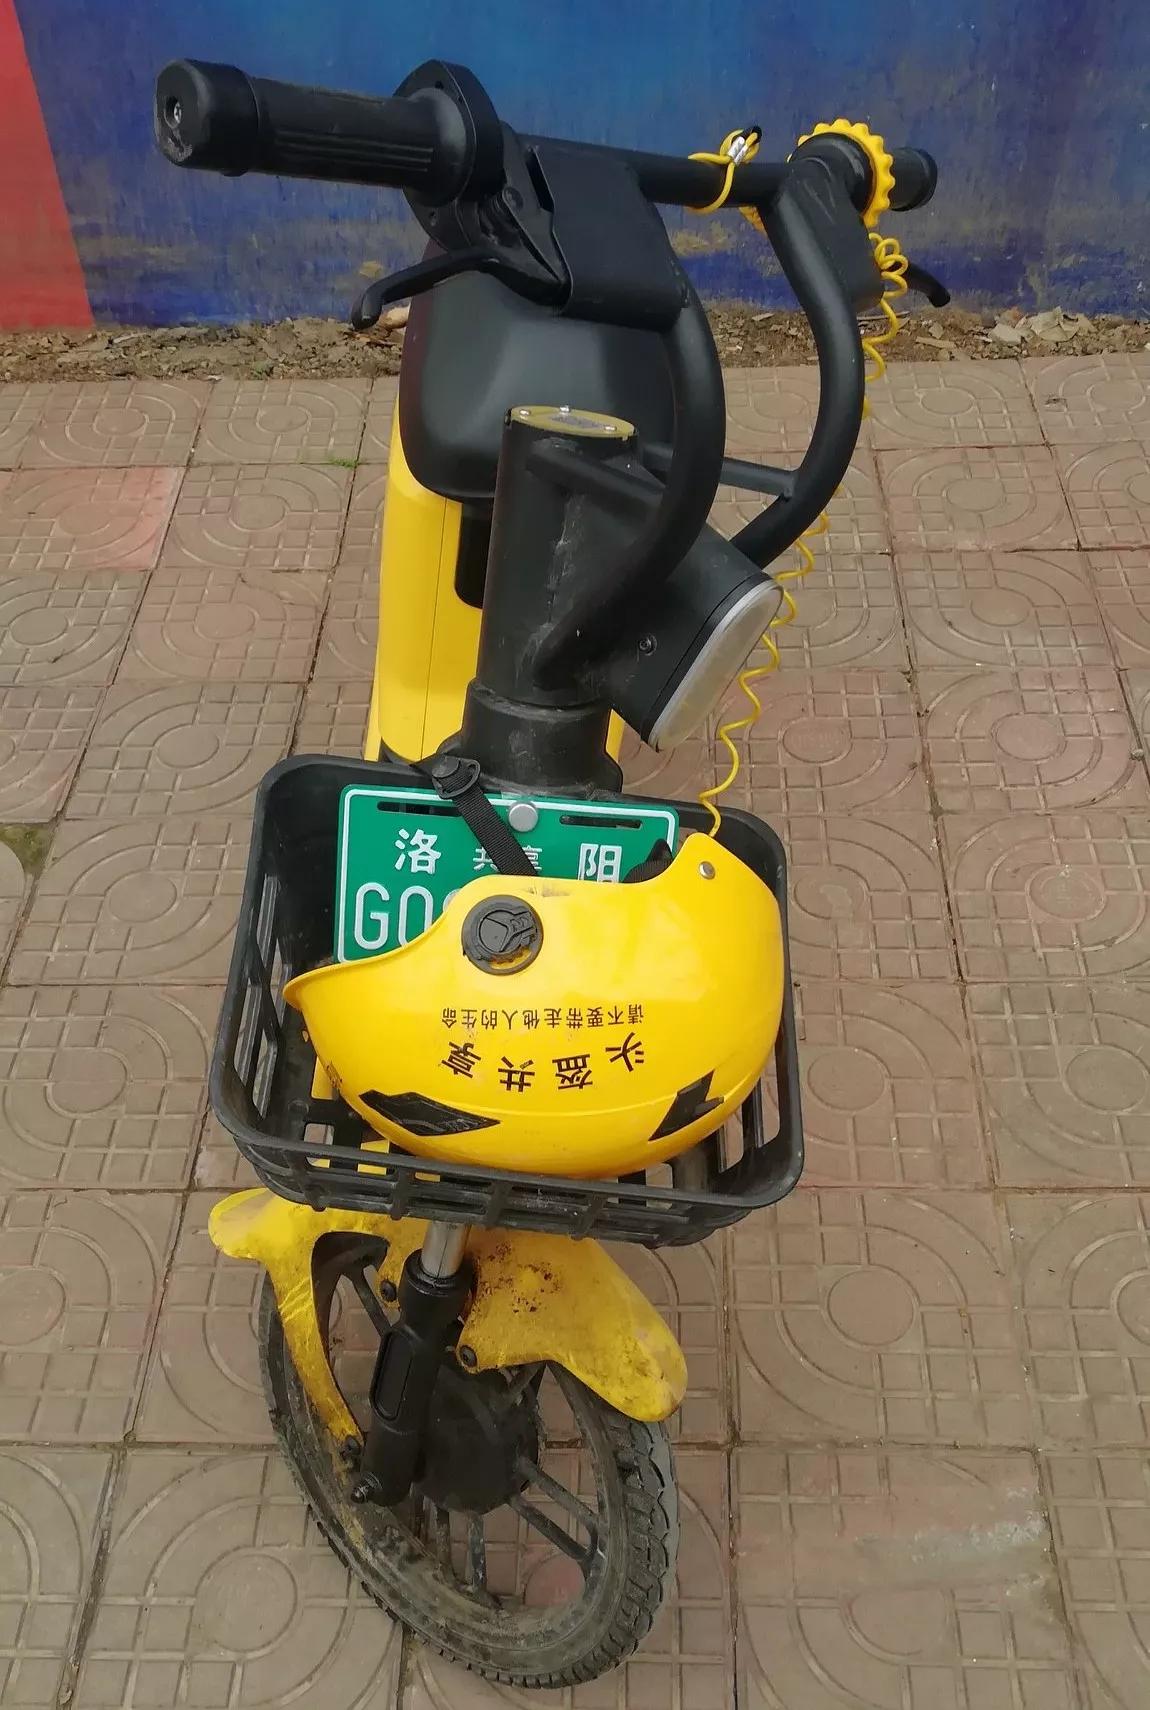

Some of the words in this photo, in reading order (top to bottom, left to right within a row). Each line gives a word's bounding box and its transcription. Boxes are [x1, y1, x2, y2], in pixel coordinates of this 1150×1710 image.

[394, 828, 442, 875] 洛
[578, 842, 623, 884] 阳
[354, 882, 460, 950] G0
[441, 1003, 645, 1031] 请不要带走他人的生命
[441, 1031, 645, 1093] 头盔共享
